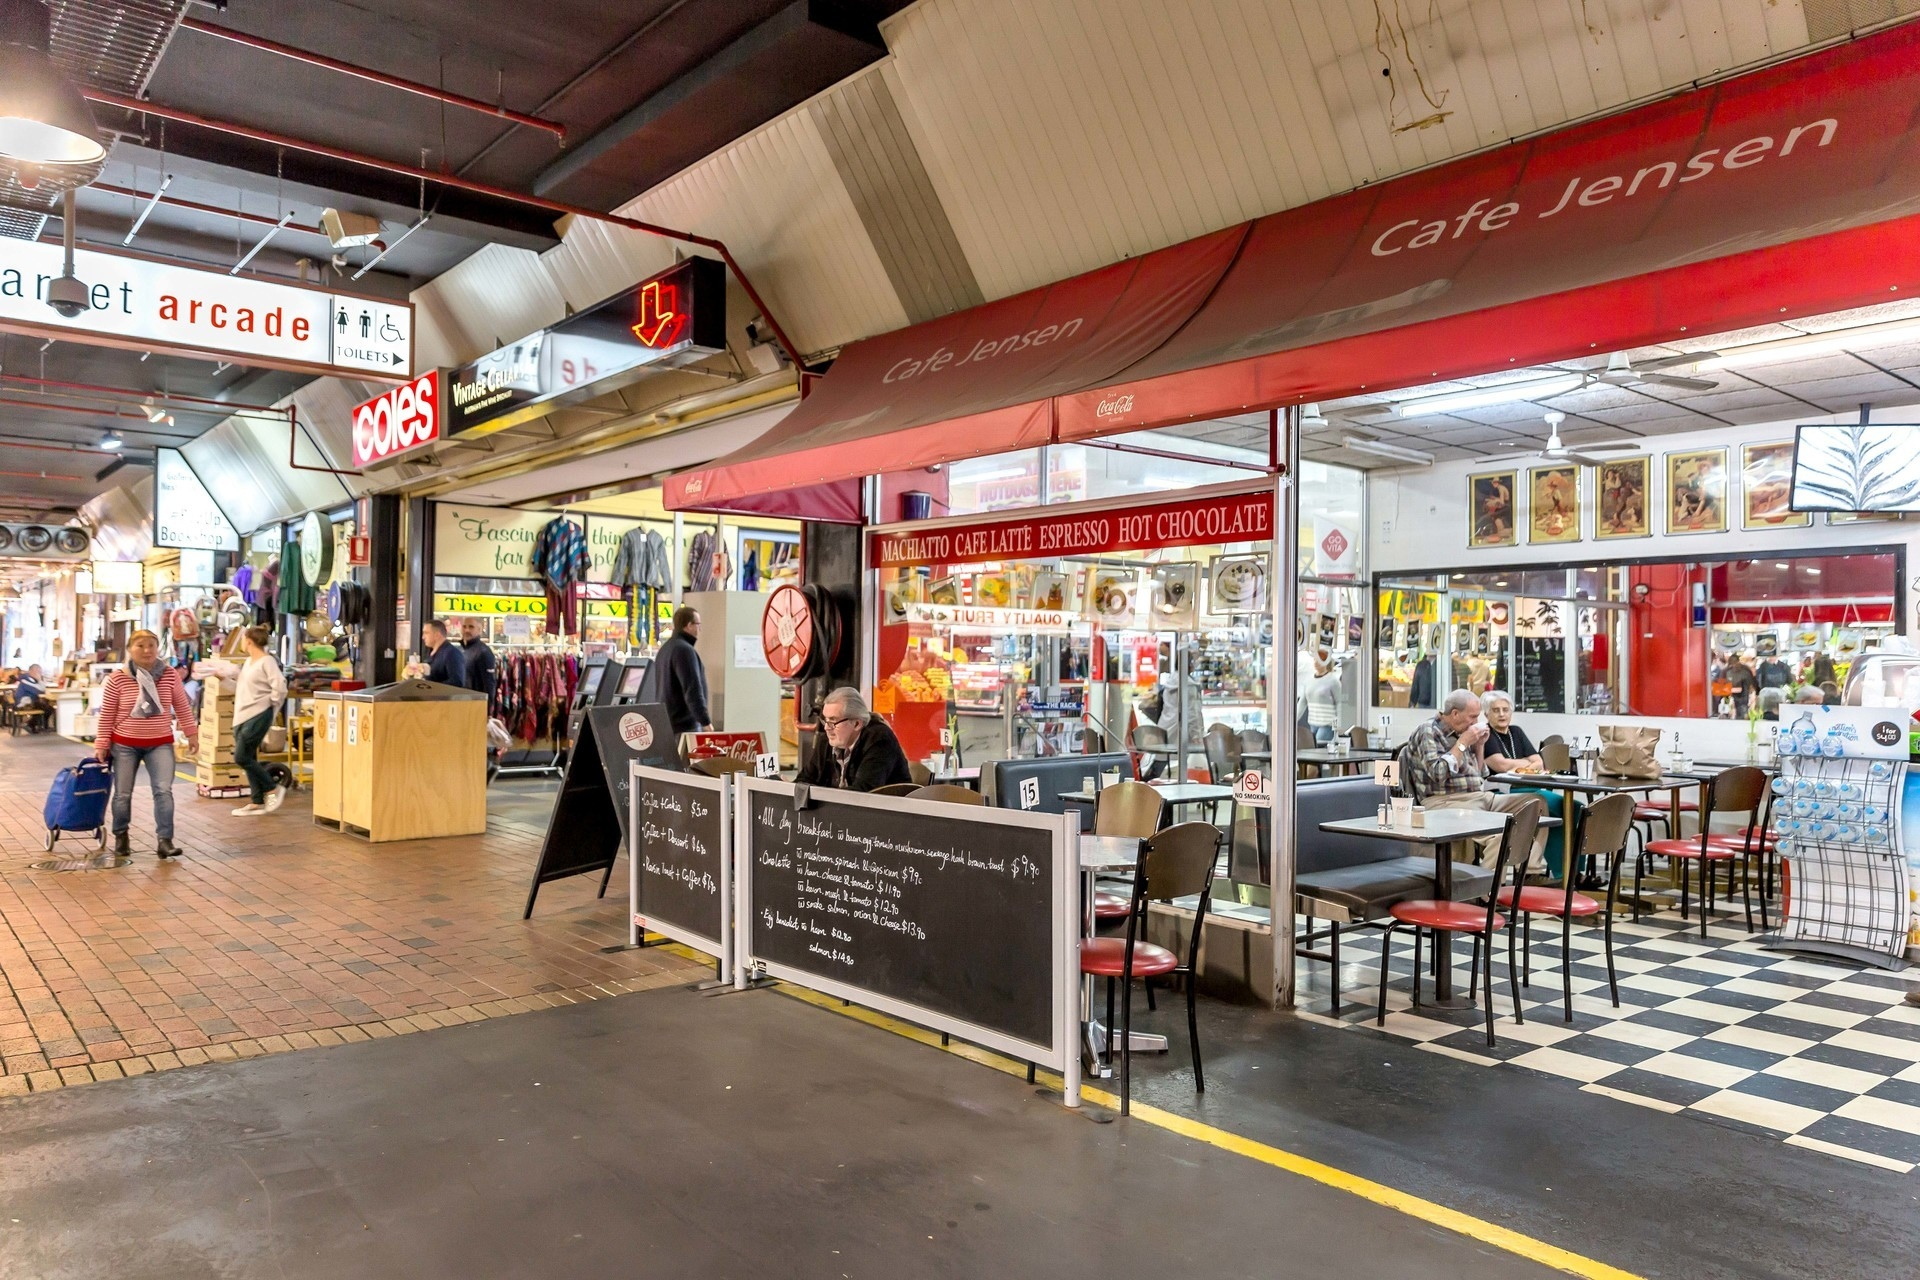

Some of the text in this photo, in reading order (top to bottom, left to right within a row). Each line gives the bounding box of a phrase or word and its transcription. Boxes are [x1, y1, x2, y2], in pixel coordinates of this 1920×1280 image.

[1370, 117, 1839, 257] Cafe Jensen
[1, 267, 311, 342] aret arcade
[337, 346, 389, 364] TOILETS
[882, 317, 1084, 385] Cafe Jensen
[453, 380, 487, 407] VINTAGE
[354, 377, 433, 463] coles
[881, 535, 950, 563] MACHIATTO
[954, 530, 988, 557] CAFE
[1039, 518, 1110, 550] ESPRESSO
[1118, 513, 1153, 543] HOT
[1155, 502, 1269, 541] CHOCOLATE
[1328, 535, 1342, 544] GO
[495, 545, 524, 571] far
[444, 597, 483, 611] The
[494, 599, 600, 615] GLOL
[1381, 716, 1391, 725] 11
[944, 731, 950, 743] 6
[1674, 732, 1680, 742] 8
[1771, 726, 1778, 736] 9
[1584, 736, 1592, 748] 7
[760, 757, 776, 773] 14
[1382, 765, 1391, 779] 4
[1022, 783, 1036, 802] 15
[762, 806, 775, 828] All
[779, 809, 792, 845] day
[797, 812, 834, 846] breakfast
[876, 880, 901, 899] $11.90
[873, 898, 899, 916] $12.90
[763, 908, 774, 929] Egg
[810, 919, 827, 936] ham
[901, 919, 926, 941] $13.90
